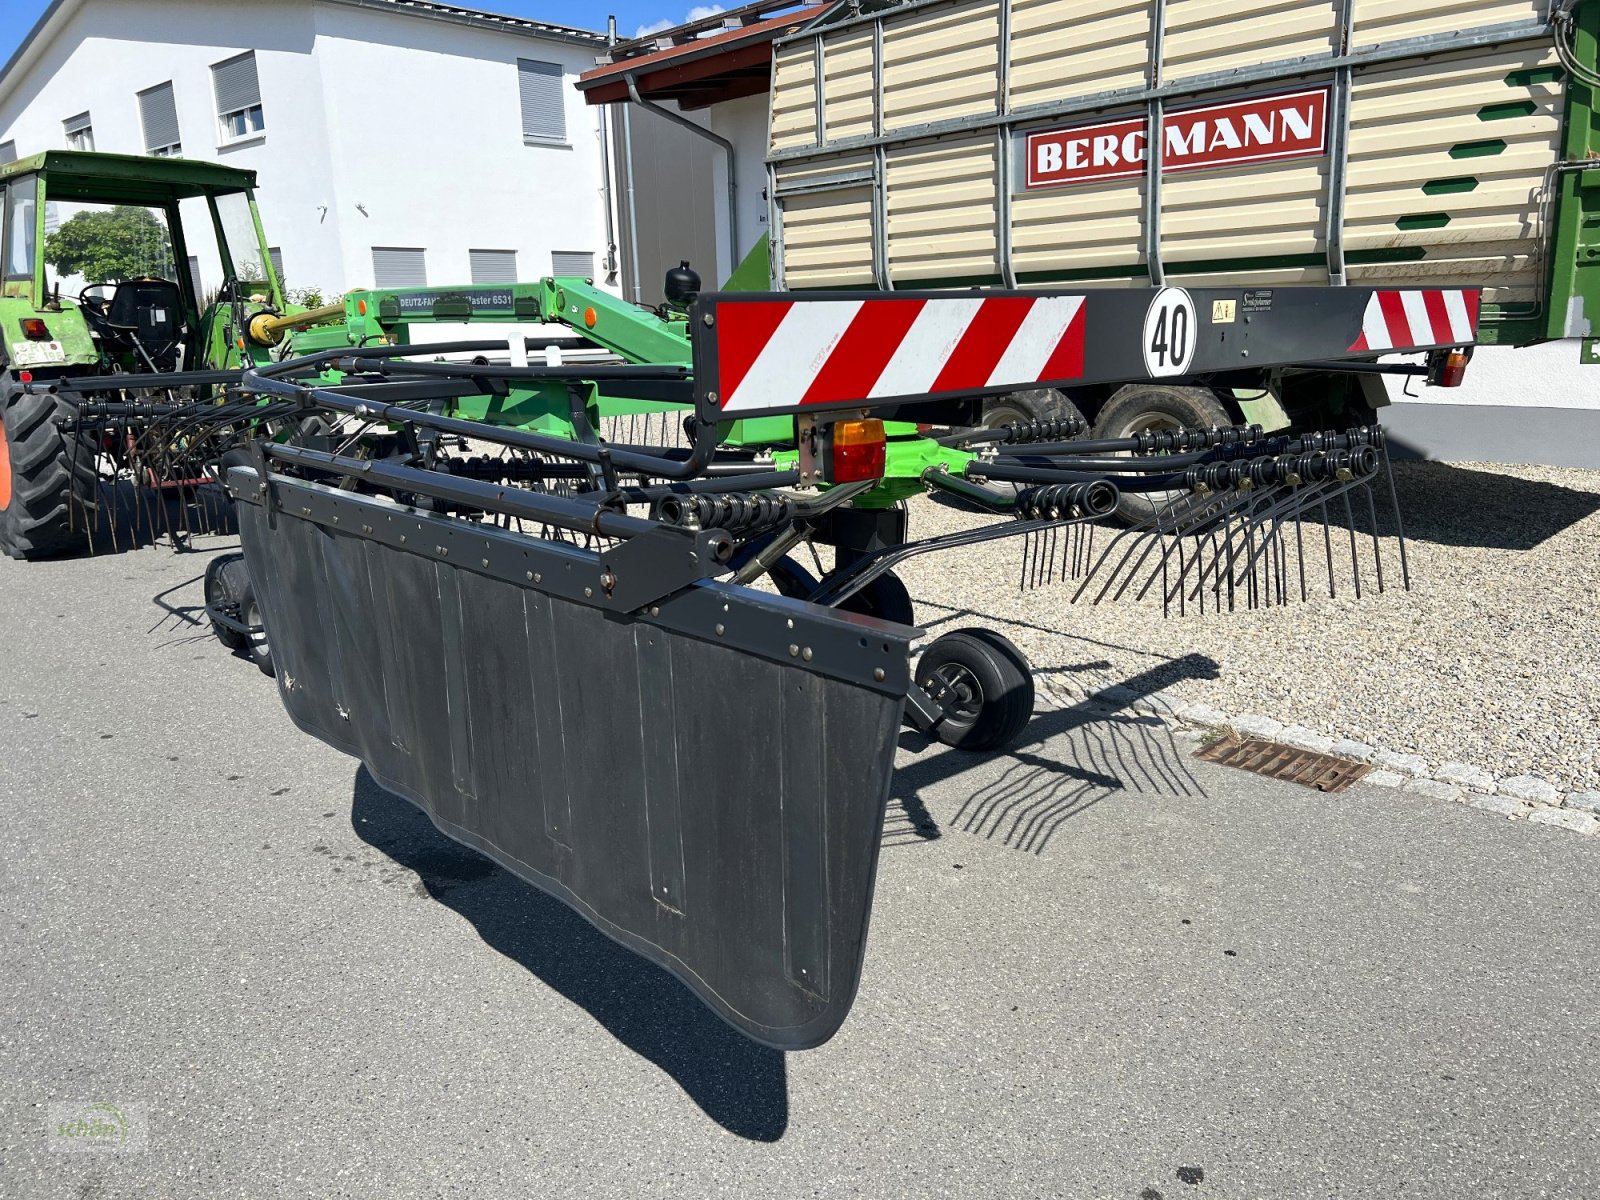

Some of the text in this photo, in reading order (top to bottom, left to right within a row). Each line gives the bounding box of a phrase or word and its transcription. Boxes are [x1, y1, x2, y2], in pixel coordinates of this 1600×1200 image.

[1037, 105, 1314, 173] BERGMANN
[400, 296, 440, 307] DEUTZ-FAH
[493, 294, 512, 305] 6531
[1151, 304, 1187, 367] 40
